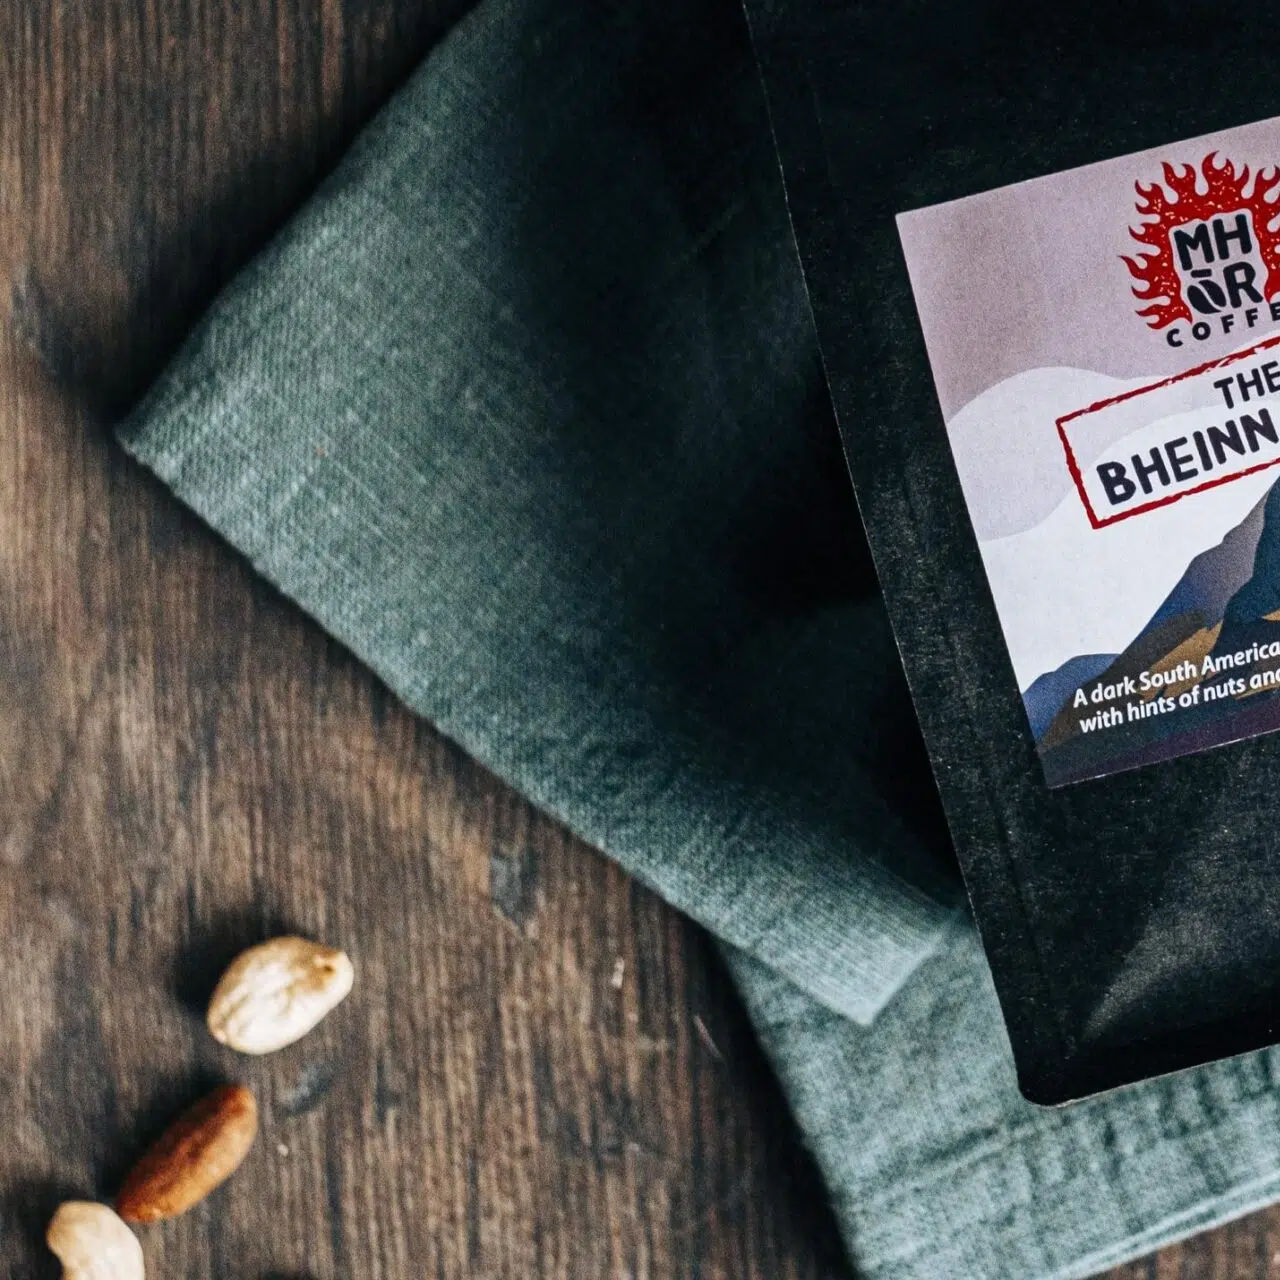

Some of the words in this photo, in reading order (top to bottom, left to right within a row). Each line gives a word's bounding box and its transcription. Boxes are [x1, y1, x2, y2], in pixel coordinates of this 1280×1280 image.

[1173, 214, 1253, 271] MH
[1096, 408, 1280, 505] BHEINN
[1073, 688, 1088, 708] A
[1090, 676, 1138, 705] dark
[1139, 660, 1198, 691] South
[1079, 705, 1123, 733] with
[1127, 693, 1176, 722] hints
[1179, 686, 1201, 709] of
[1203, 676, 1245, 704] nuts
